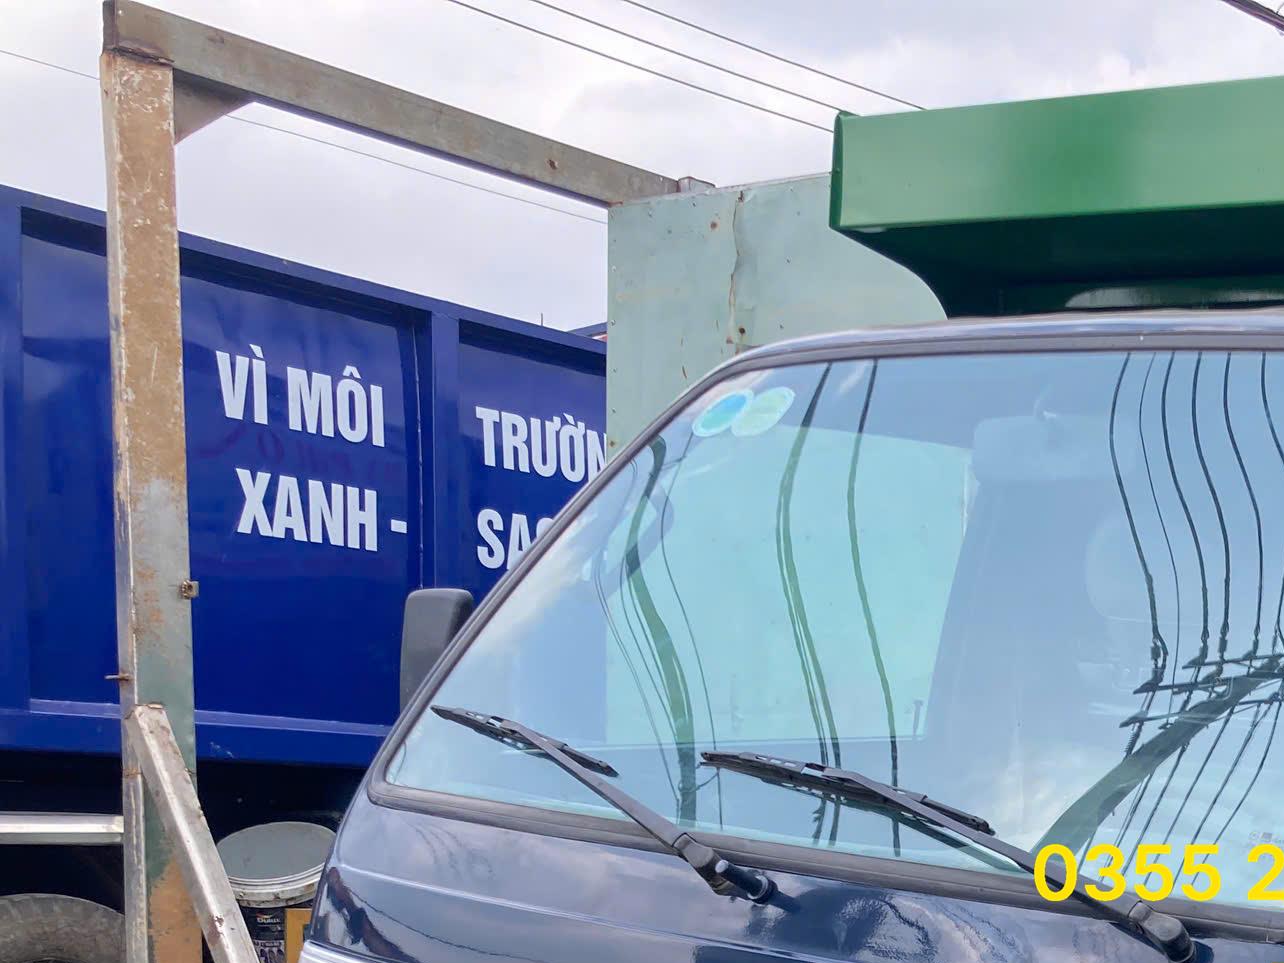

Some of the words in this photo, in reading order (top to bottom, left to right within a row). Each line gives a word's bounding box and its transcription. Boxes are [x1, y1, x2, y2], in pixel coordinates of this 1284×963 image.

[216, 344, 268, 425] VÌ
[287, 365, 385, 447] MÔI
[235, 468, 378, 552] XANH
